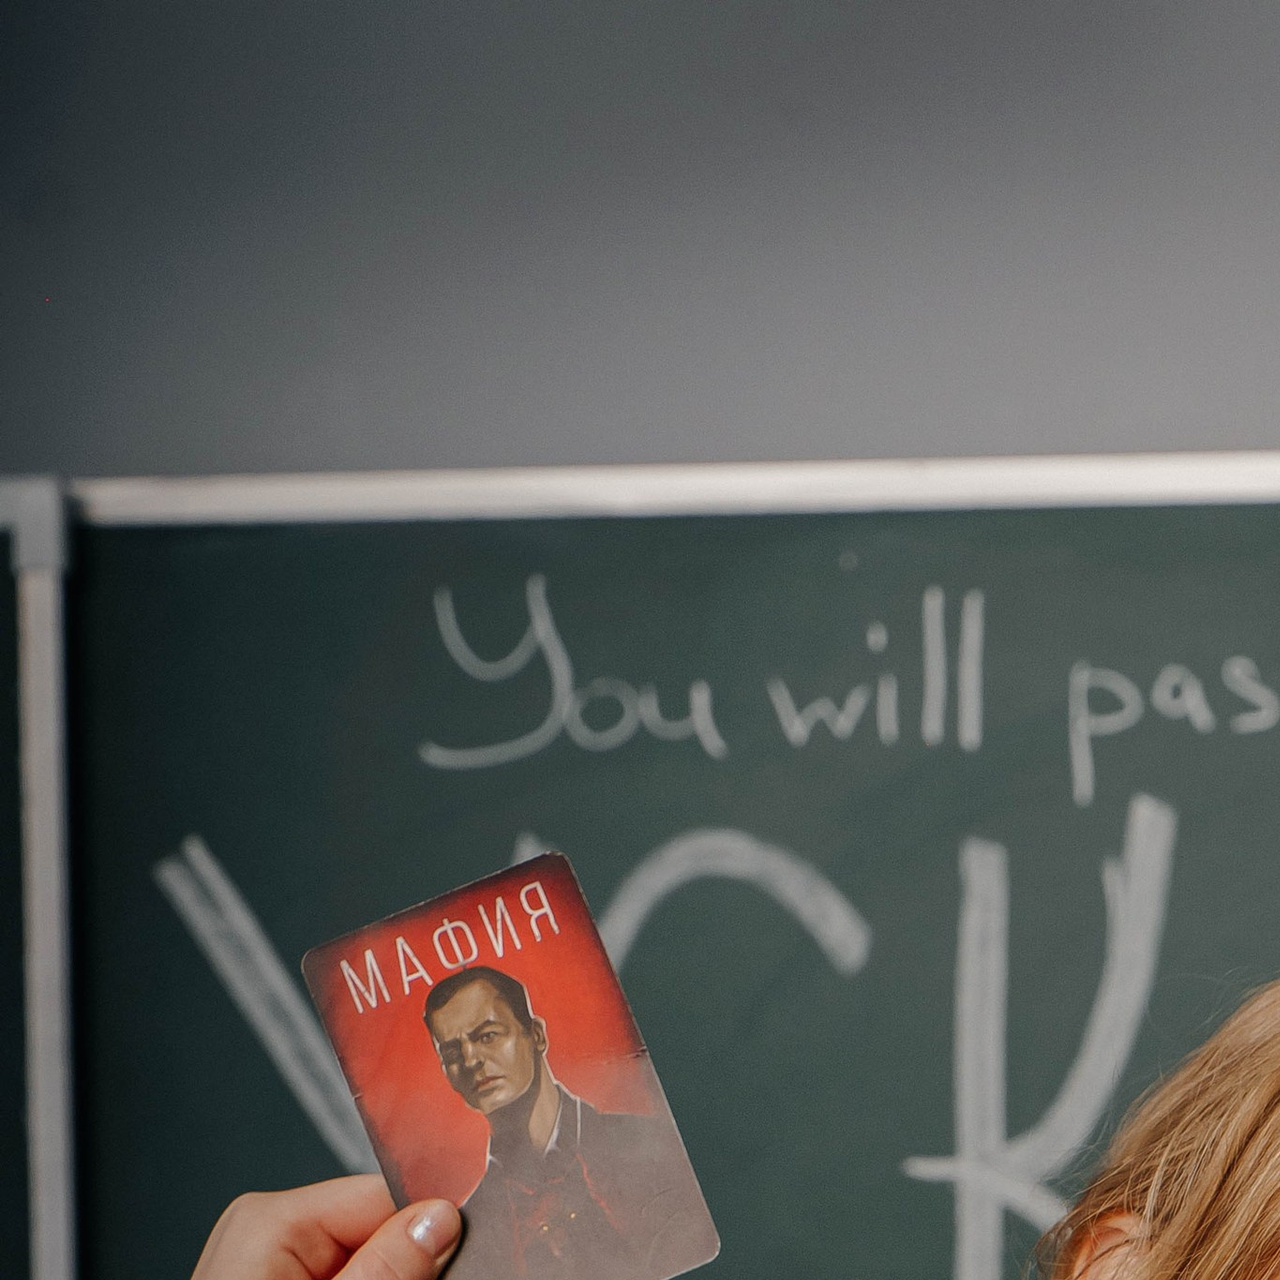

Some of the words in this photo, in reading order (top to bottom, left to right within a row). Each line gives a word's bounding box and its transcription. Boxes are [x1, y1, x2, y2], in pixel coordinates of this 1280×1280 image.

[418, 573, 729, 770] You
[766, 584, 986, 753] will
[339, 880, 562, 1016] МАФИЯ
